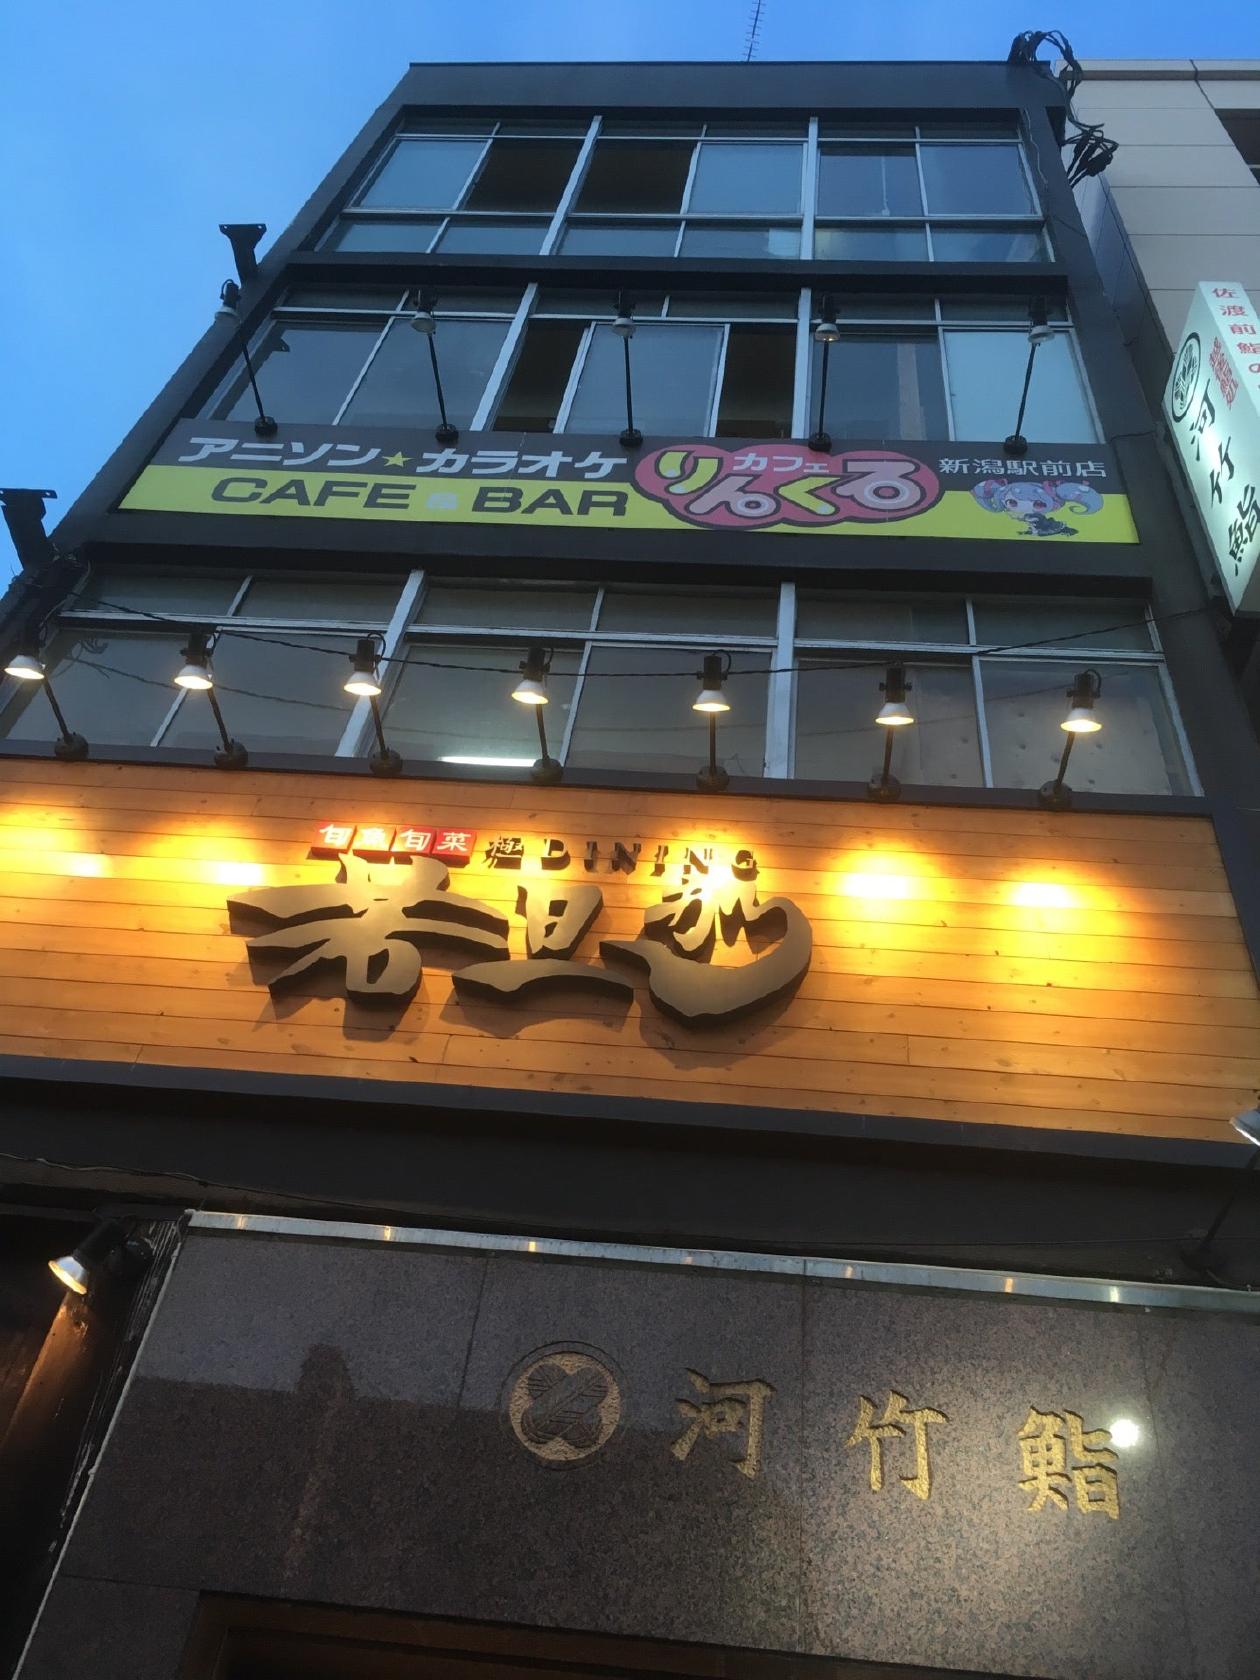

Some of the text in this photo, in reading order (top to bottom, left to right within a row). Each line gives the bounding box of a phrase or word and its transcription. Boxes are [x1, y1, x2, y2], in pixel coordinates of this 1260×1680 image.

[733, 453, 830, 474] カフェ
[938, 457, 1107, 478] 新潟駅前店
[211, 477, 416, 510] CAFE
[471, 486, 630, 517] BAR
[658, 450, 925, 518] りんくる
[318, 823, 473, 853] 旬魚旬菜
[671, 1367, 1120, 1520] 河竹鮨
